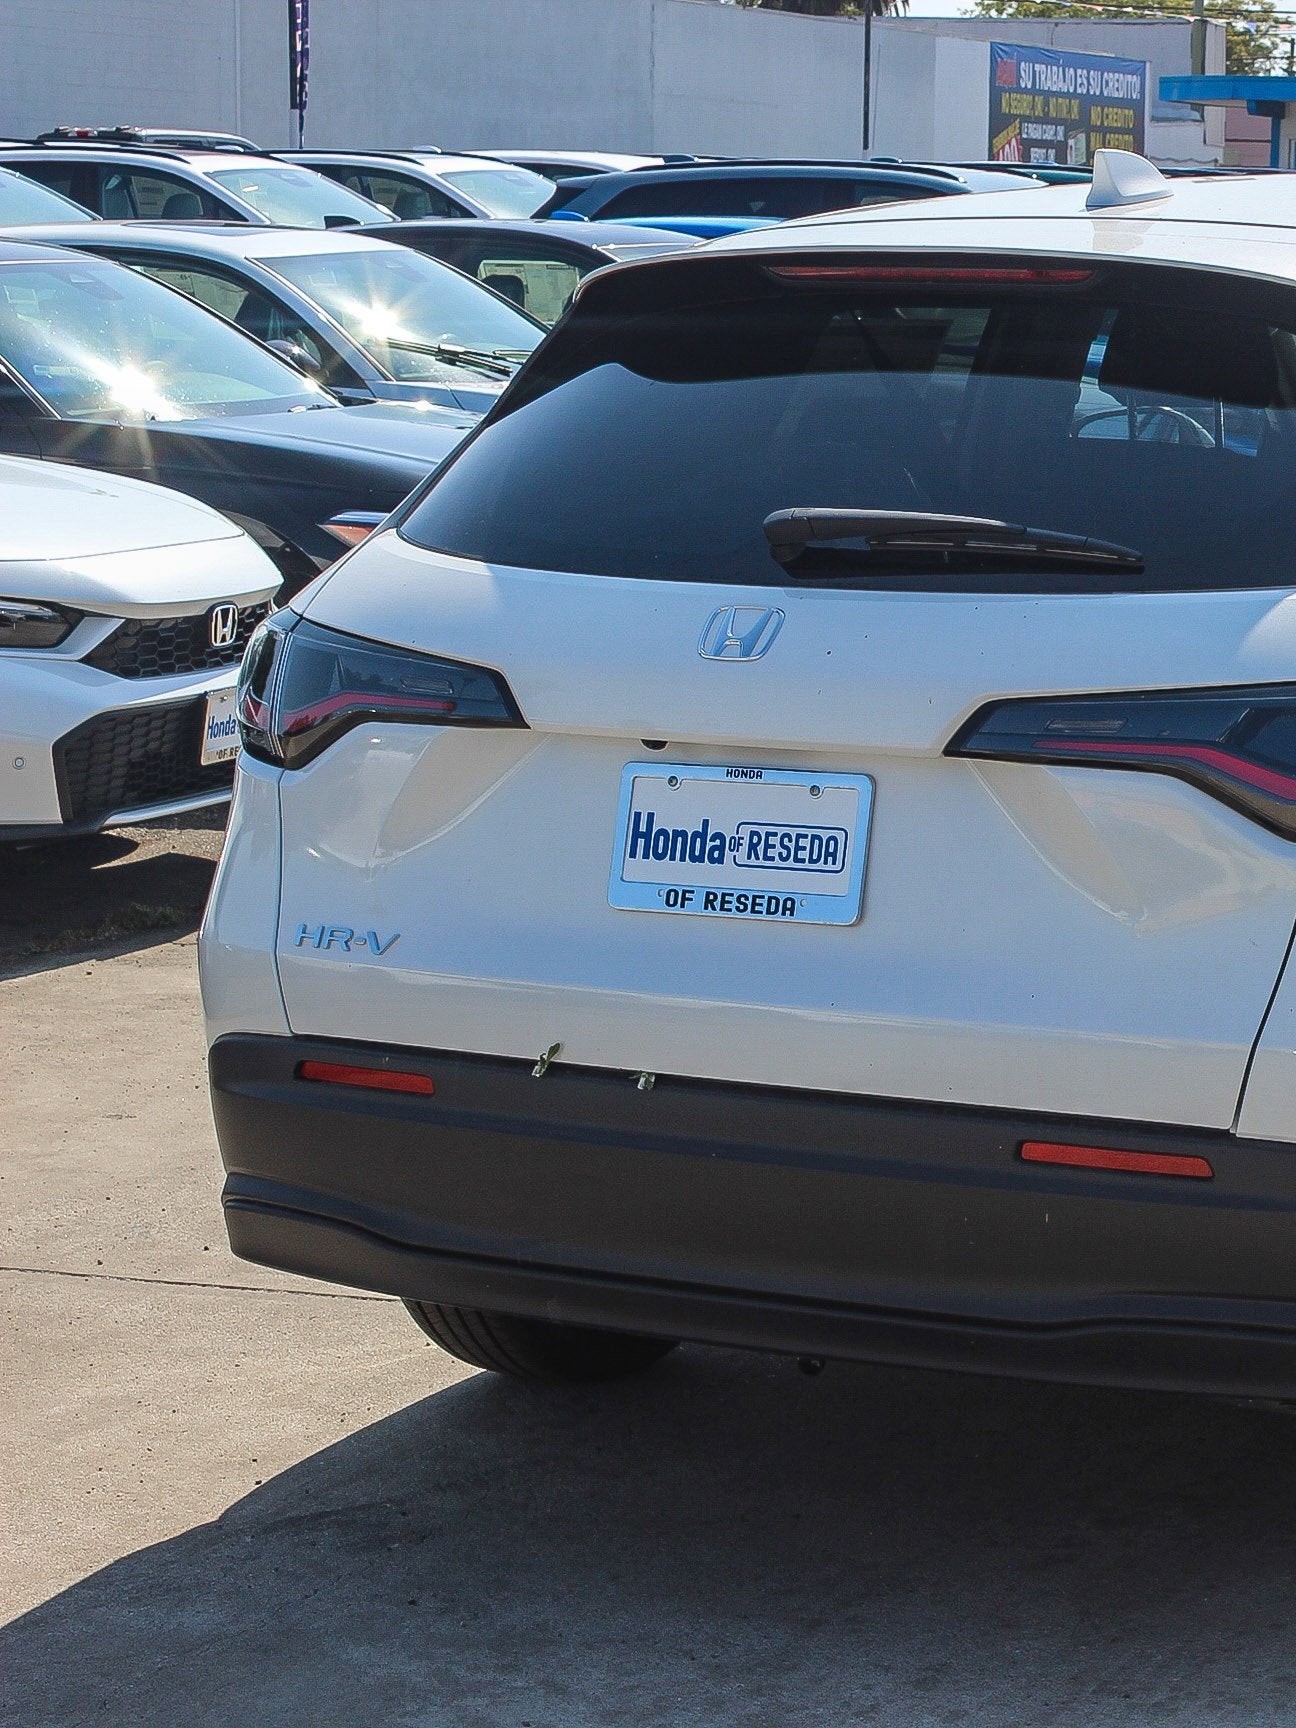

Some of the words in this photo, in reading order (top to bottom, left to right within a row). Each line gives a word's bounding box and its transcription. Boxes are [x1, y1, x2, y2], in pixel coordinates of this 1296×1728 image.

[1019, 61, 1033, 89] SU
[1076, 68, 1088, 94] ES
[1089, 70, 1101, 96] SU
[1090, 105, 1101, 126] NO
[1103, 106, 1134, 129] CREDITO
[207, 713, 237, 740] Honda
[725, 767, 764, 781] HONDA
[628, 810, 728, 866] Honda
[728, 836, 745, 853] OF
[746, 829, 840, 867] RESEDA
[665, 888, 696, 910] OF
[703, 890, 797, 918] RESEDA
[294, 923, 401, 956] HR-V
